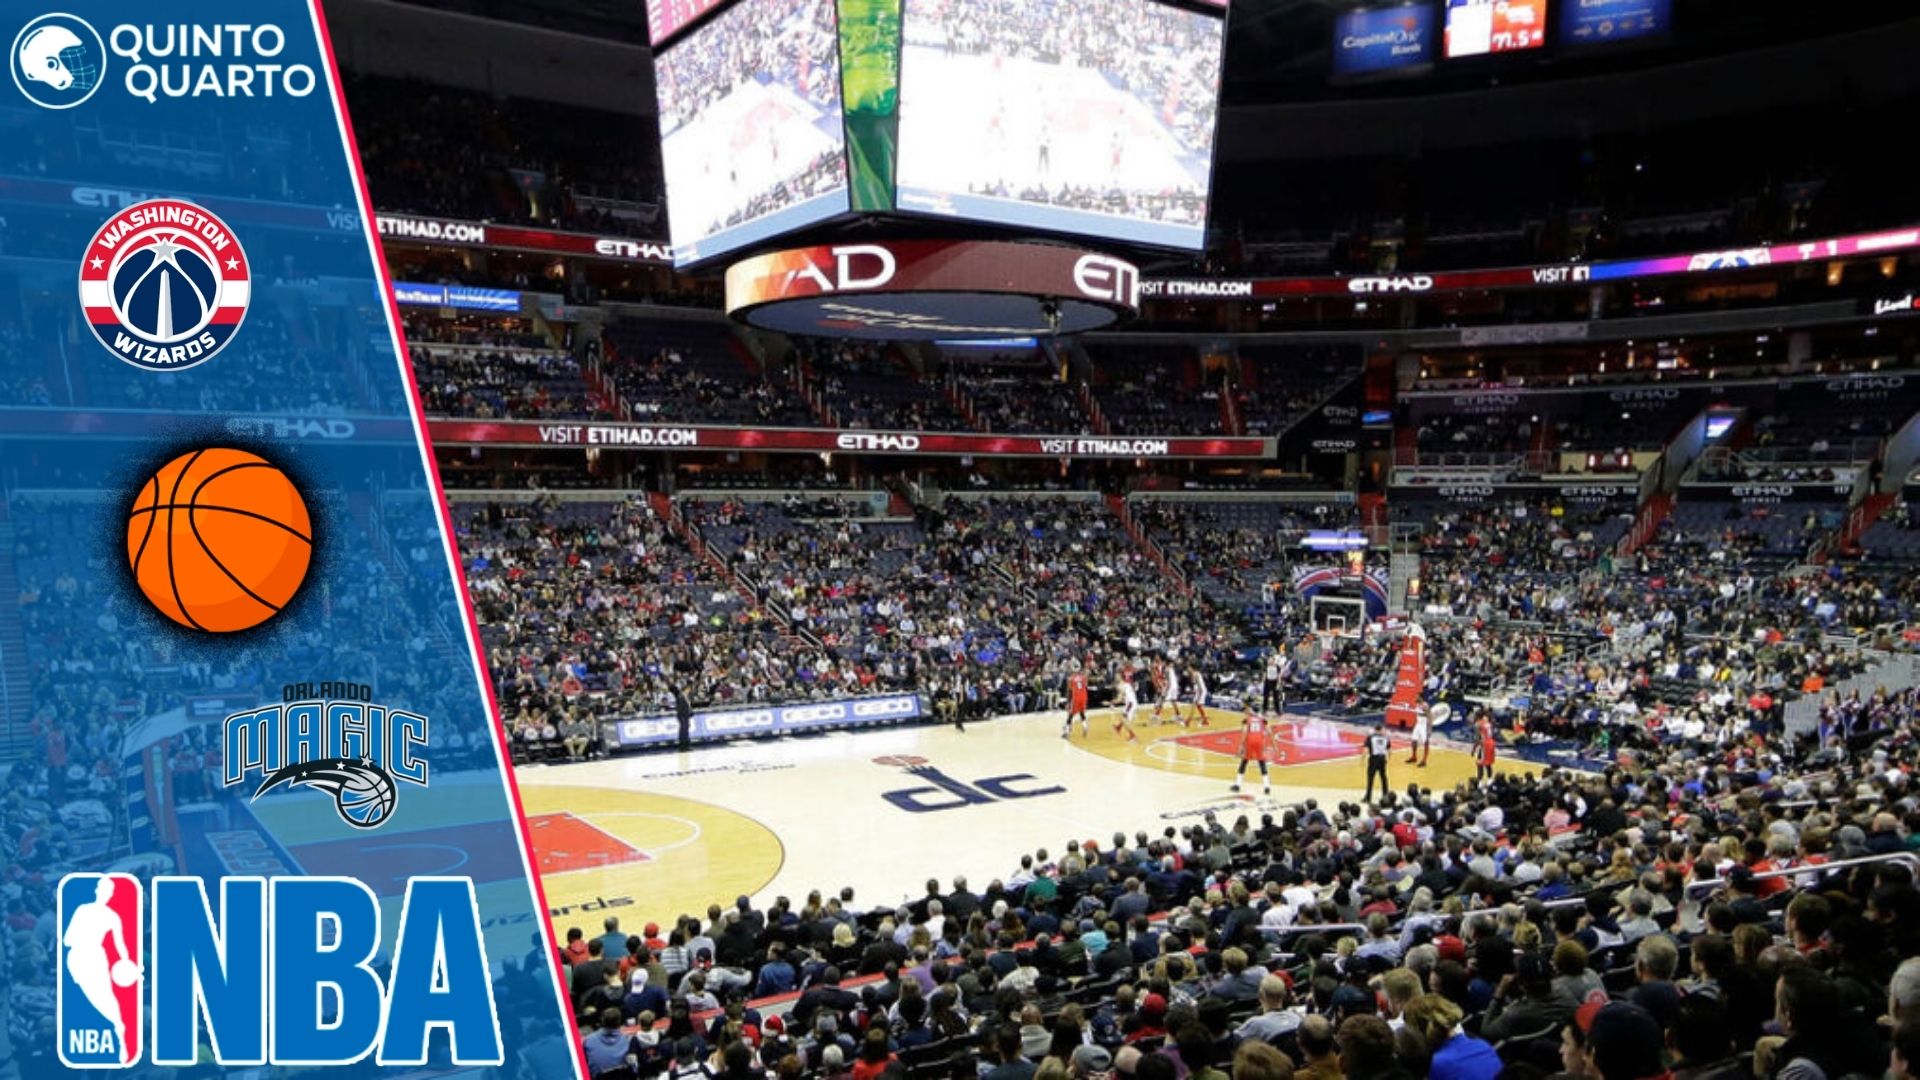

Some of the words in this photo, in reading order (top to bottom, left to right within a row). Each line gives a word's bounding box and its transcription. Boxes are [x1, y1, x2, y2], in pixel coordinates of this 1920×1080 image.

[1347, 275, 1434, 293] ETIHAD
[1532, 266, 1569, 284] VISIT
[1166, 281, 1253, 295] ETIHAD.COM
[539, 426, 582, 442] VISIT
[587, 428, 697, 445] ETIHAD.COM
[837, 434, 920, 450] ETIHAD
[1040, 439, 1074, 453] VISIT
[1077, 440, 1168, 455] ETIHAD.COM
[781, 703, 846, 724] GEICO
[852, 695, 914, 716] GEICO
[705, 710, 774, 731] GEICO
